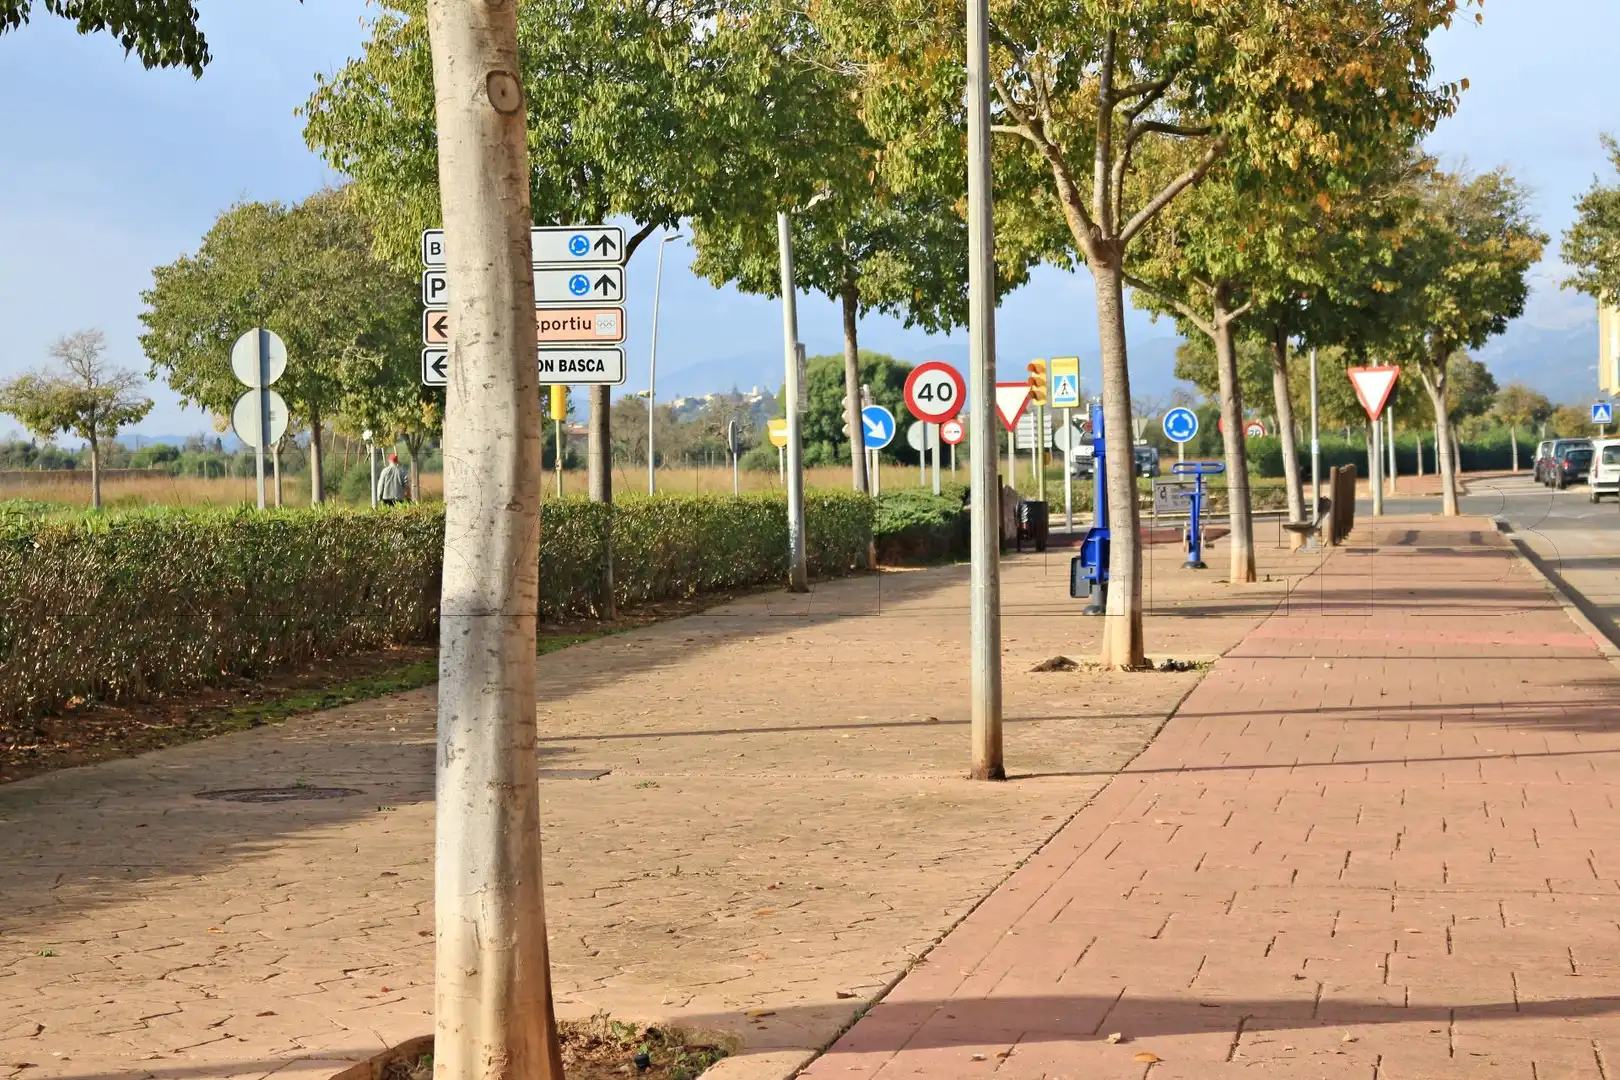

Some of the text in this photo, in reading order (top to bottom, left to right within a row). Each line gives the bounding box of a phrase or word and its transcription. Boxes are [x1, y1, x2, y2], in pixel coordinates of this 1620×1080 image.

[430, 241, 446, 255] B
[558, 359, 605, 372] BASCA
[917, 382, 953, 402] 40
